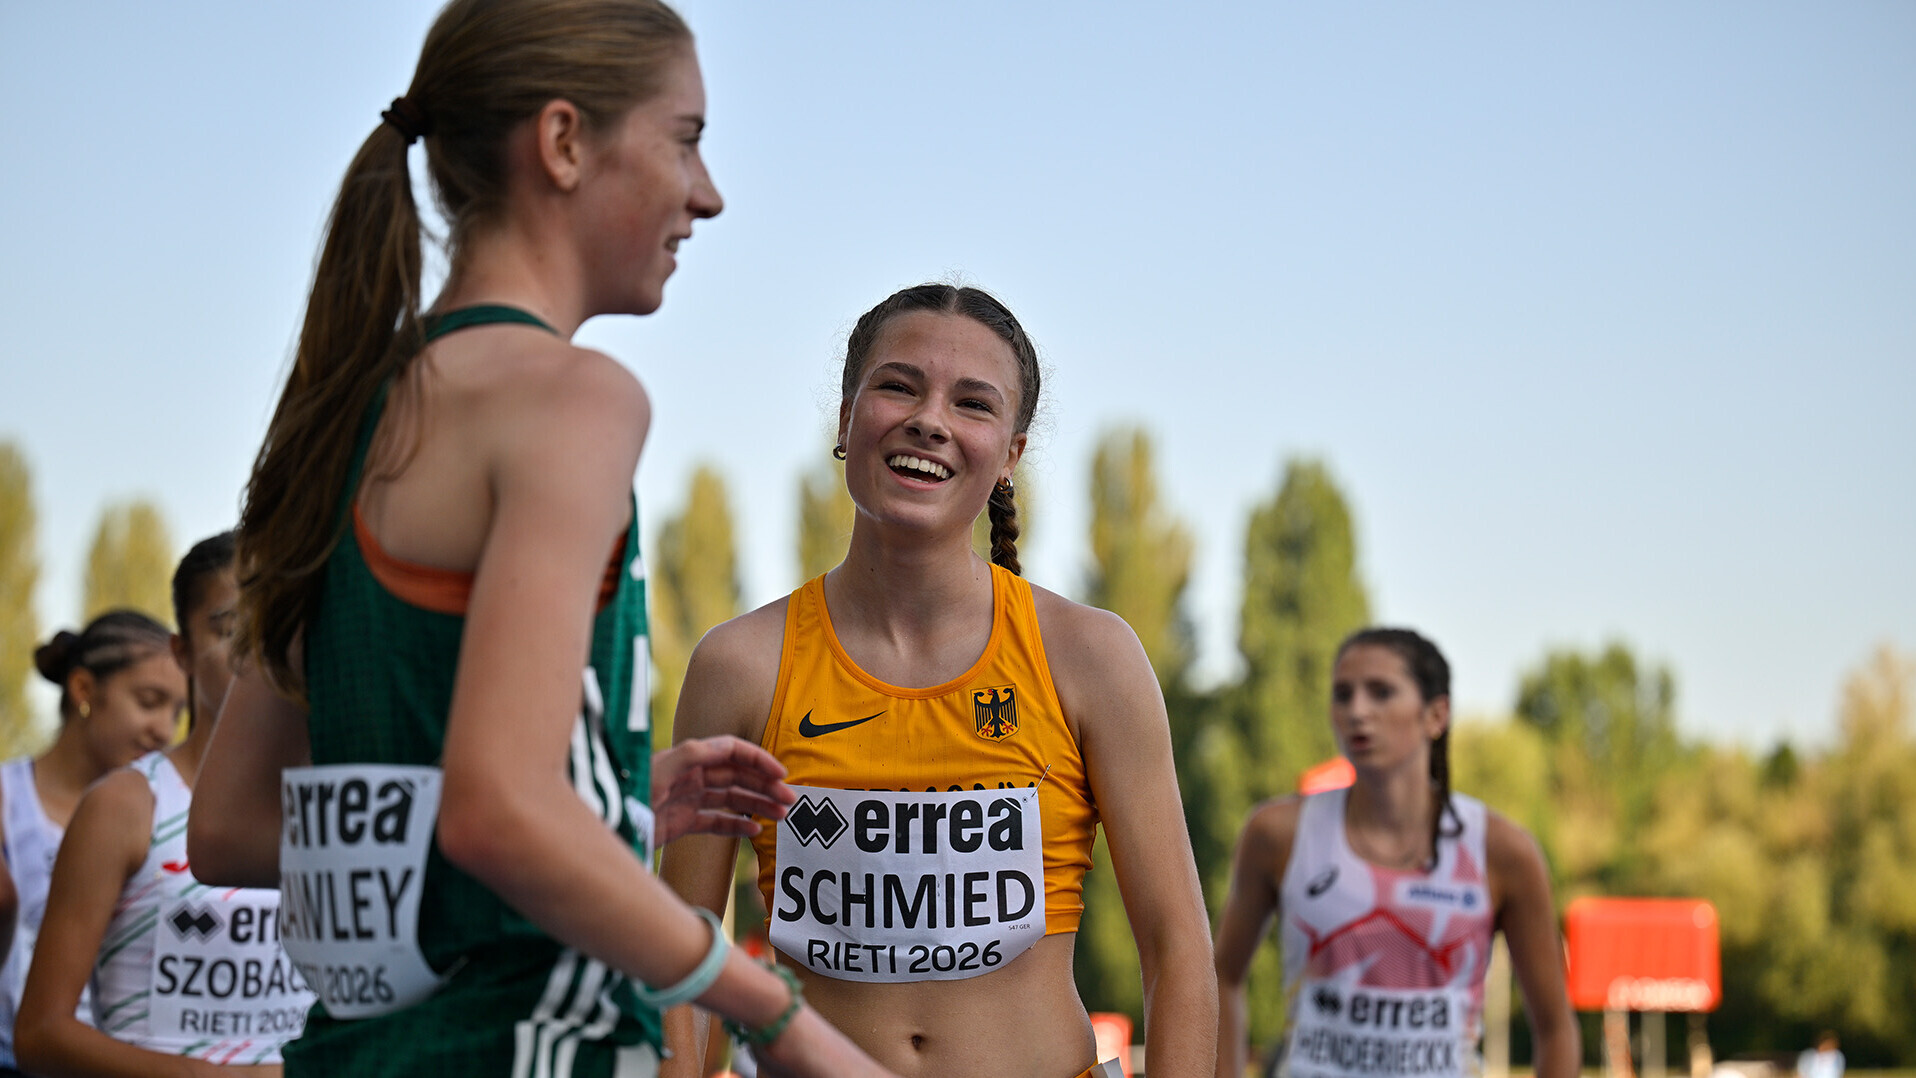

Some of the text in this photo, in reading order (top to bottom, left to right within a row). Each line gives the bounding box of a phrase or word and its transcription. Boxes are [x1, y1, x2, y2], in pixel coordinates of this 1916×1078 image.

[777, 866, 1035, 929] SCHMIED
[807, 939, 1003, 974] RIETI 2026
[179, 1008, 252, 1035] RIETI
